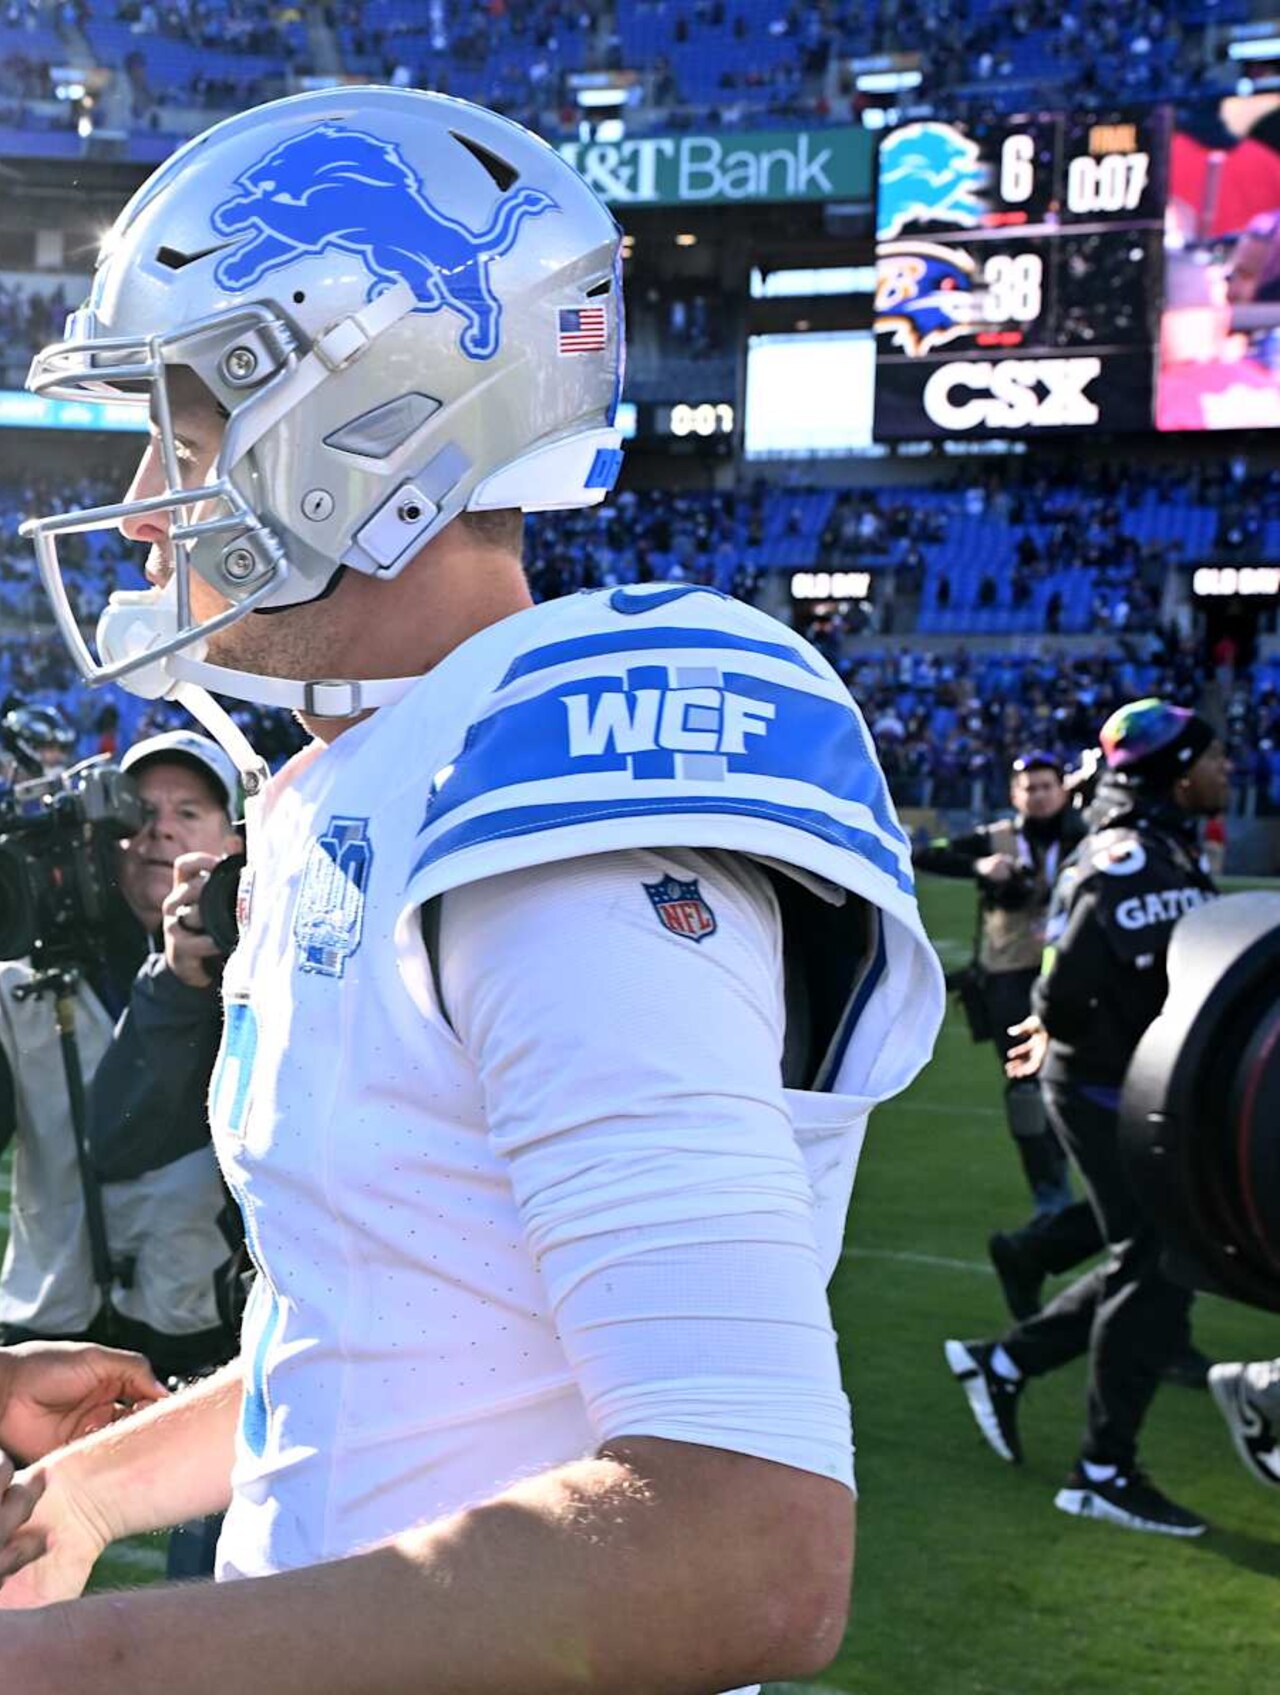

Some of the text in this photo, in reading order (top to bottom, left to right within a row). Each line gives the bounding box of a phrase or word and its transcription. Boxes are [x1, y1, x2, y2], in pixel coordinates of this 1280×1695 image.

[678, 133, 834, 199] Bank
[1000, 133, 1036, 203] 6
[983, 253, 1043, 322] 38
[923, 356, 1102, 431] CSX
[560, 687, 776, 758] WCF
[662, 901, 712, 935] NFL
